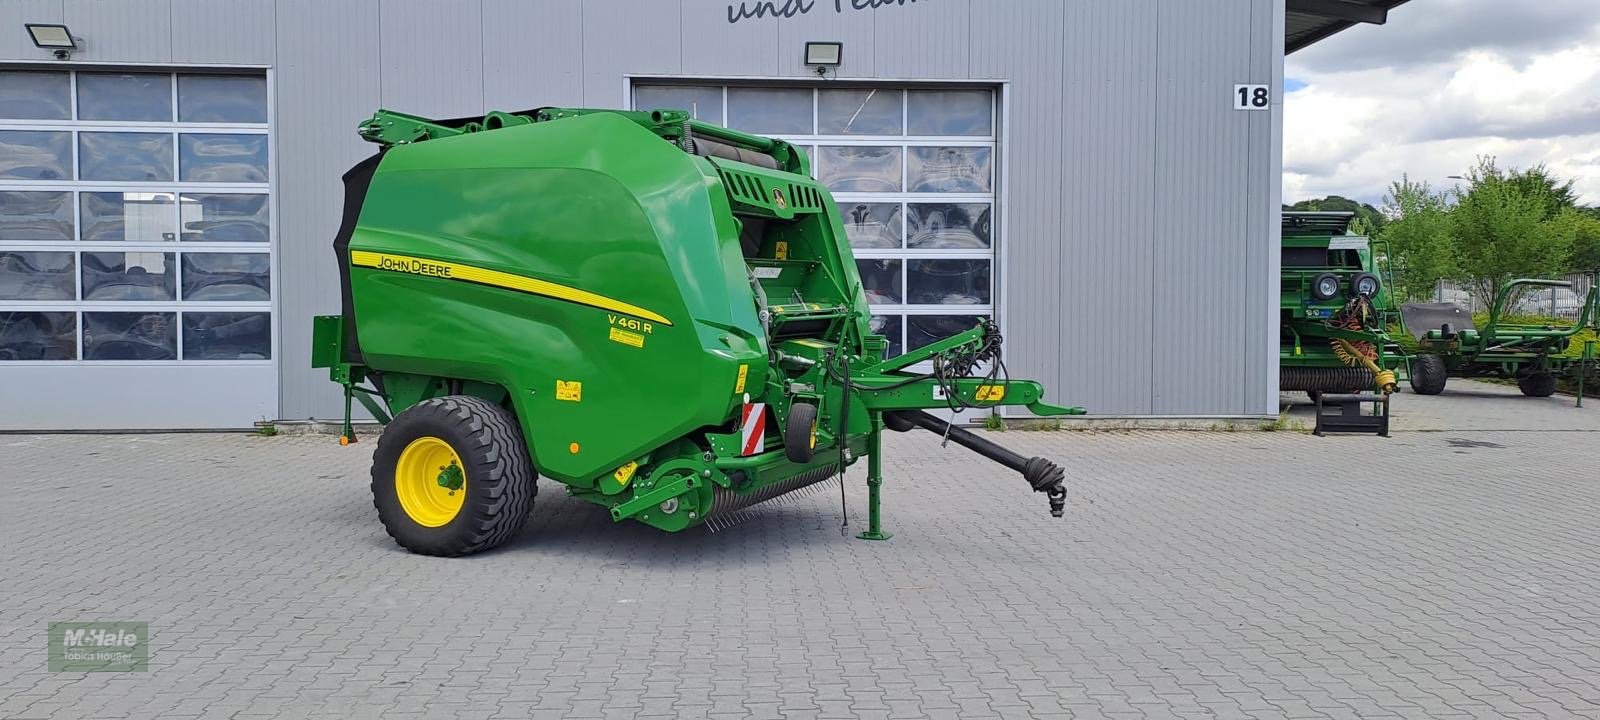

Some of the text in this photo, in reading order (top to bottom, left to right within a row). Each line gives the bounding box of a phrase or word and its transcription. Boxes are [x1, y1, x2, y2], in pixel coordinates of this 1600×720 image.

[1238, 87, 1268, 107] 18
[378, 256, 451, 276] JOHN DEERE
[608, 314, 652, 334] V 461 R
